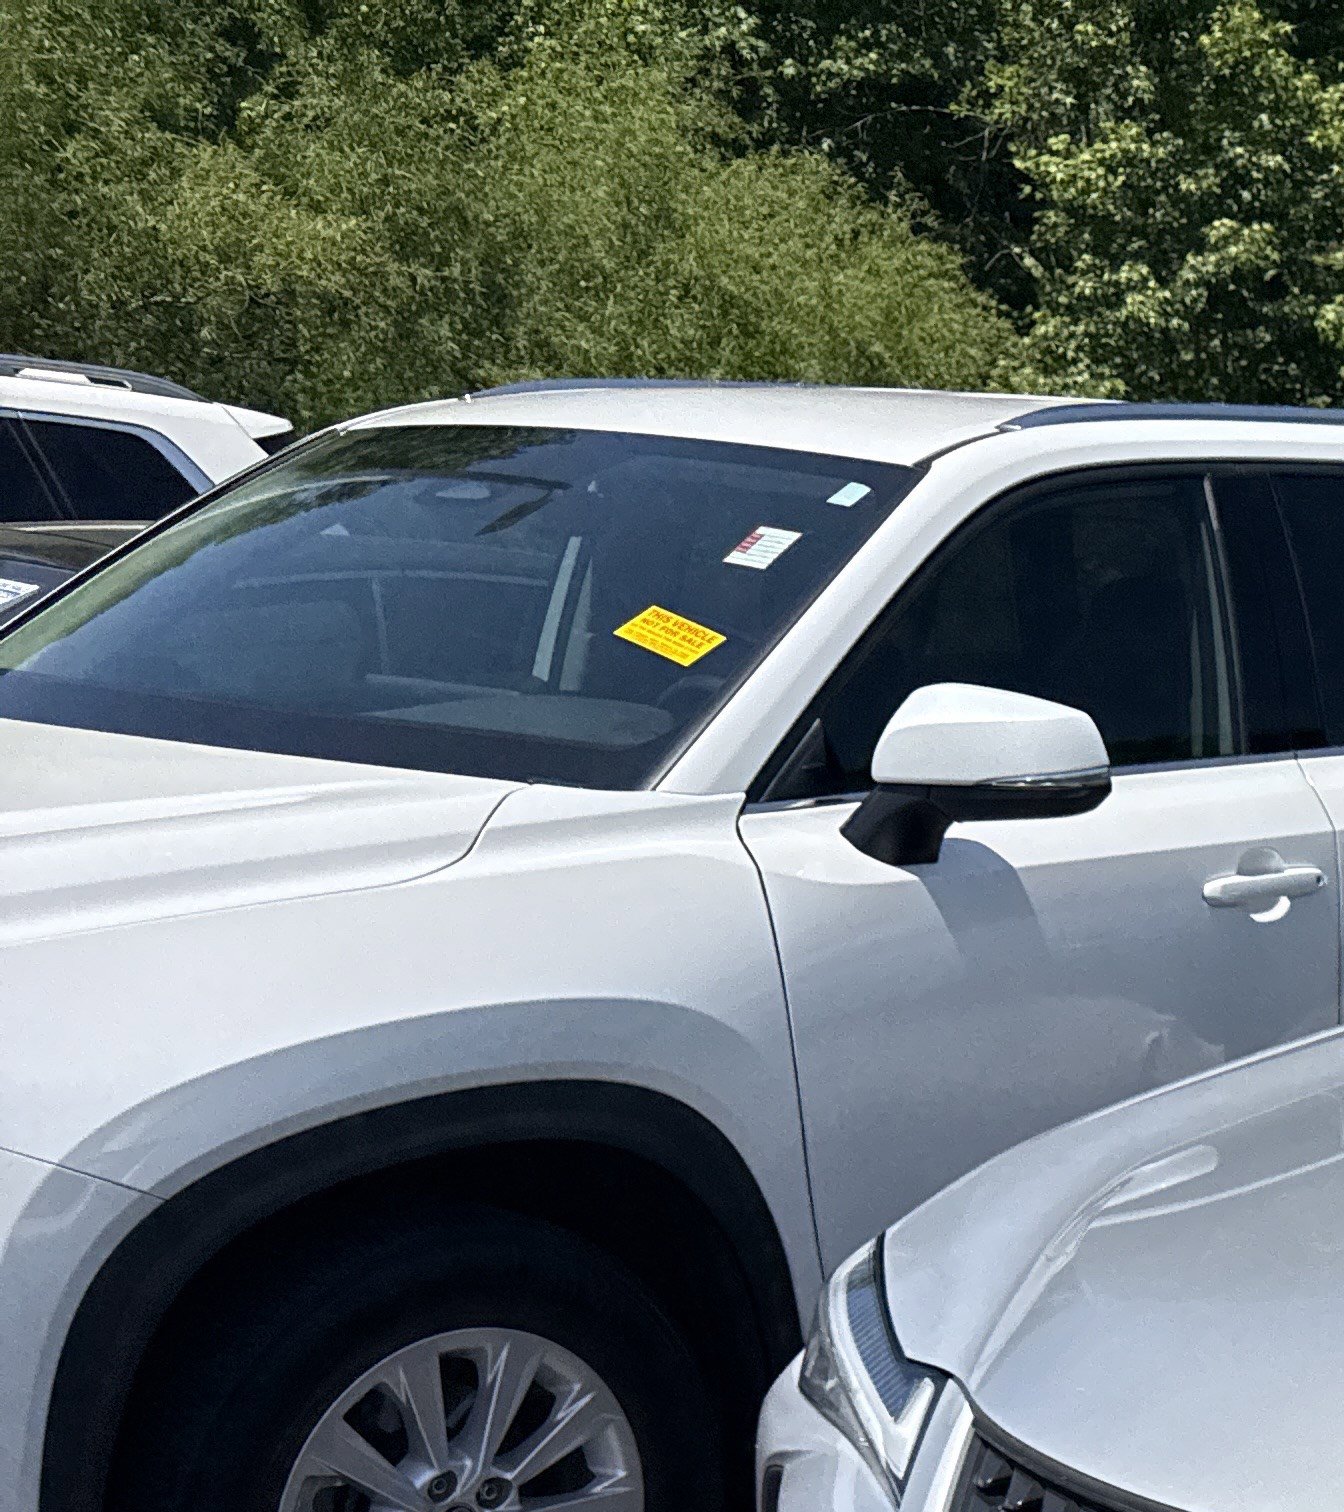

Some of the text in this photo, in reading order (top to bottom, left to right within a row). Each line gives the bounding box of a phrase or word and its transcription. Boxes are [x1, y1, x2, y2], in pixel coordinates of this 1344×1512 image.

[641, 618, 705, 649] NOT FOR SALE
[648, 609, 673, 624] THIS
[672, 619, 719, 644] VEHICLE
